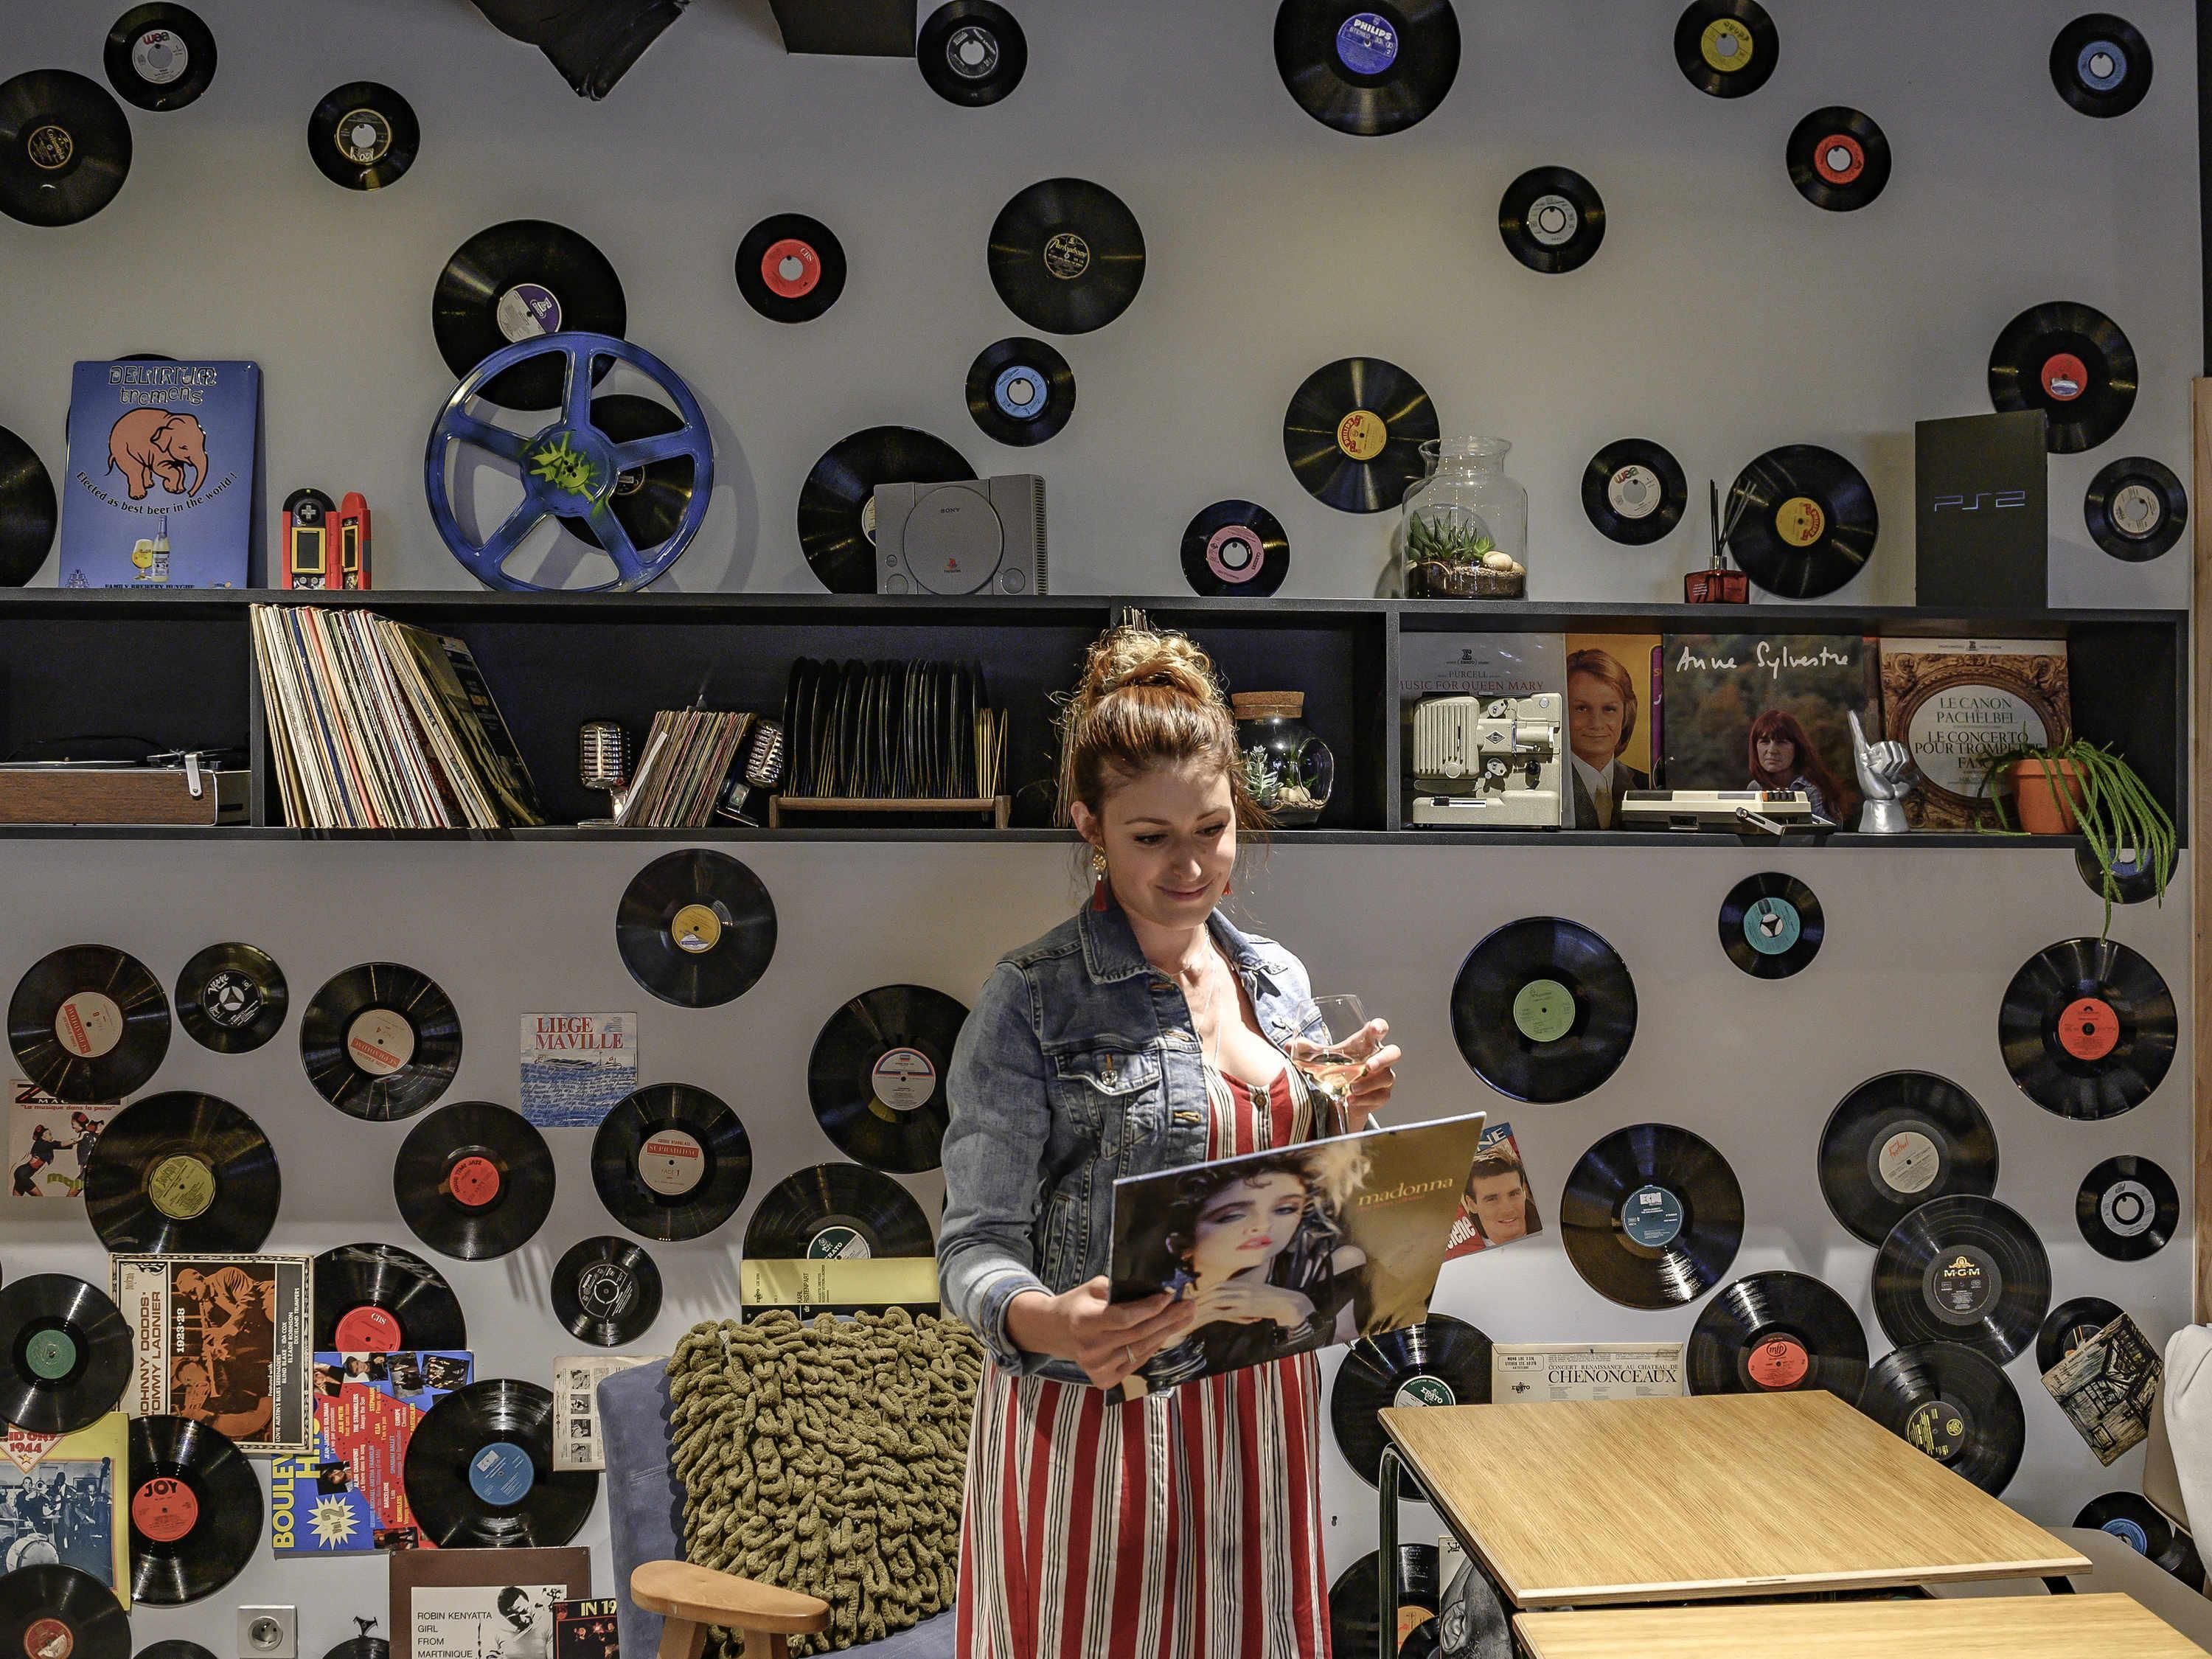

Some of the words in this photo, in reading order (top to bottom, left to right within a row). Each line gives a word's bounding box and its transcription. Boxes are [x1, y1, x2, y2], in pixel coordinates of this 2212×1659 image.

[1354, 18, 1392, 40] PHILIPS
[143, 32, 170, 45] wea
[108, 366, 217, 385] DELIRIUM
[120, 386, 204, 405] tremens
[1614, 467, 1640, 484] wea
[77, 472, 107, 501] Elected
[108, 498, 118, 507] as
[122, 501, 143, 514] best
[147, 506, 170, 515] beer
[173, 503, 184, 512] in
[187, 496, 204, 509] the
[206, 477, 232, 499] world
[1934, 491, 2025, 512] PS2
[1676, 646, 1737, 672] Anne
[1756, 641, 1848, 679] Sylvestre
[1436, 681, 1458, 690] FOR
[1462, 681, 1503, 691] QUEEN
[1509, 681, 1544, 690] MARY
[1941, 698, 1958, 709] LE
[1960, 698, 2012, 709] CANON
[1936, 712, 2018, 723] PACHELBEL
[1928, 731, 1945, 742] LE
[1947, 731, 2028, 742] CONCERTO
[1915, 742, 1953, 754] POUR
[537, 1018, 593, 1033] LIEGE
[1358, 1178, 1453, 1206] madonna
[152, 1291, 160, 1358] LADNIER
[372, 1313, 388, 1326] CBS
[1548, 1370, 1677, 1383] CHENONCEAUX
[9, 1431, 25, 1441] ID
[10, 1442, 42, 1453] 1944
[144, 1481, 178, 1498] JOY
[321, 1506, 344, 1521] 2
[580, 1601, 597, 1616] IN
[417, 1638, 444, 1646] FROM
[417, 1650, 473, 1658] MARTINIQUE
